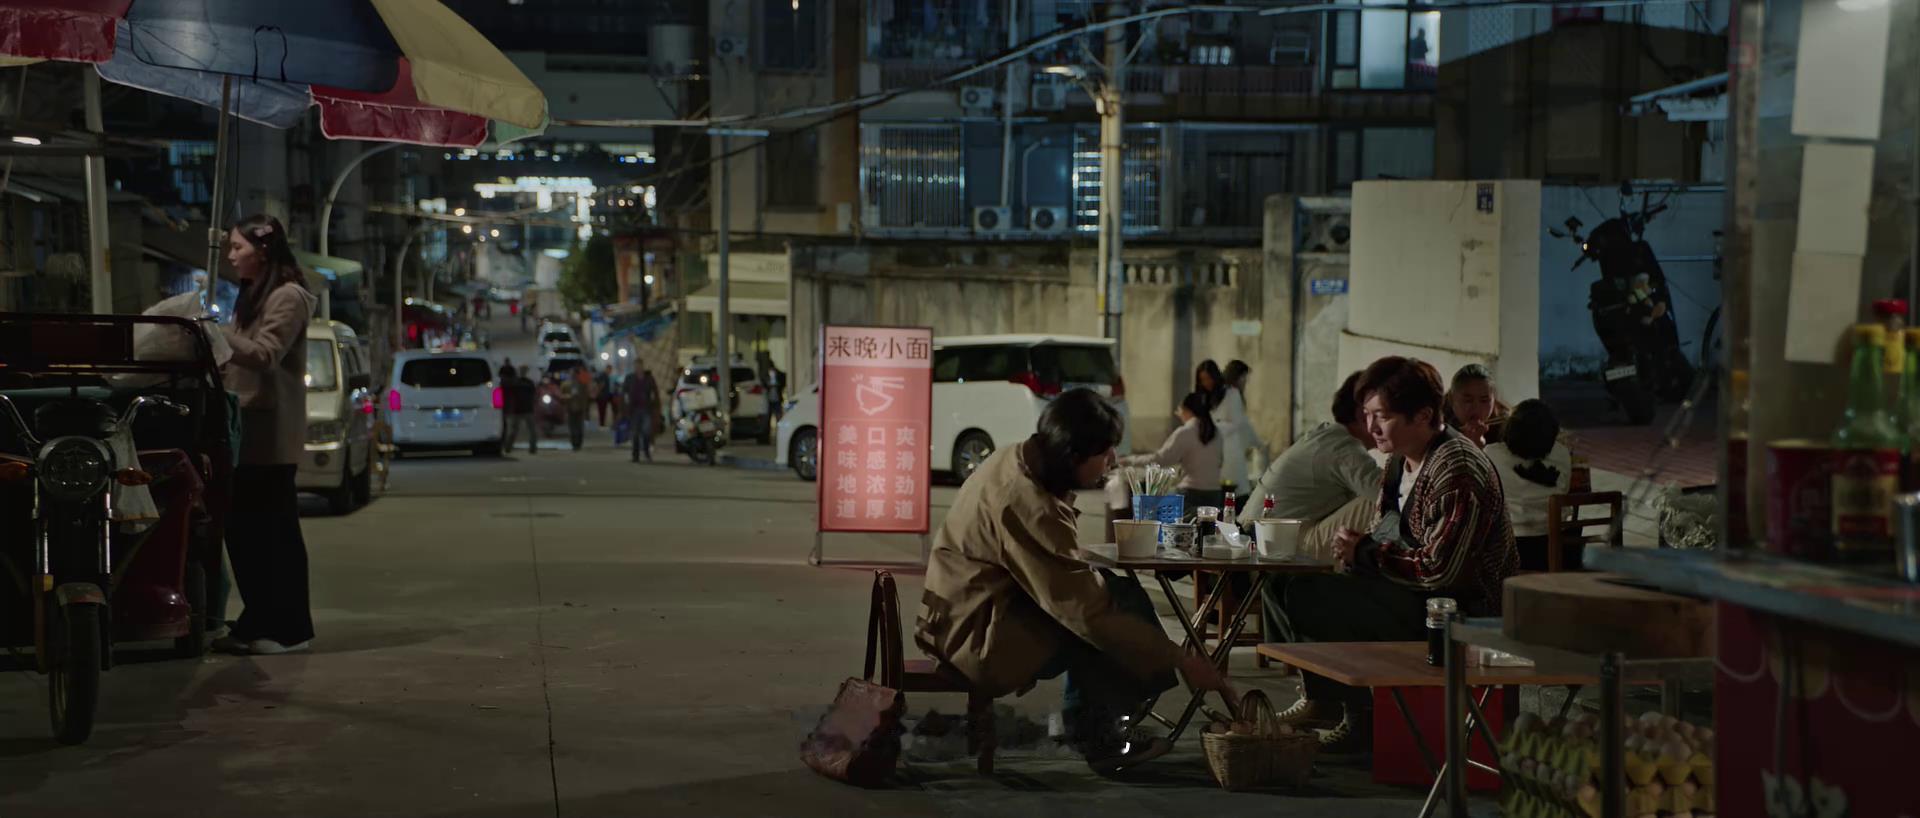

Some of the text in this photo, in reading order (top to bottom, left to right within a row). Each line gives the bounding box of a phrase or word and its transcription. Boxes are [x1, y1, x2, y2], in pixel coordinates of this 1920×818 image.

[828, 335, 928, 360] 来晚小面
[836, 425, 858, 519] 美味地道
[866, 426, 886, 519] 口感浓厚
[895, 426, 916, 520] 爽滑劲道
